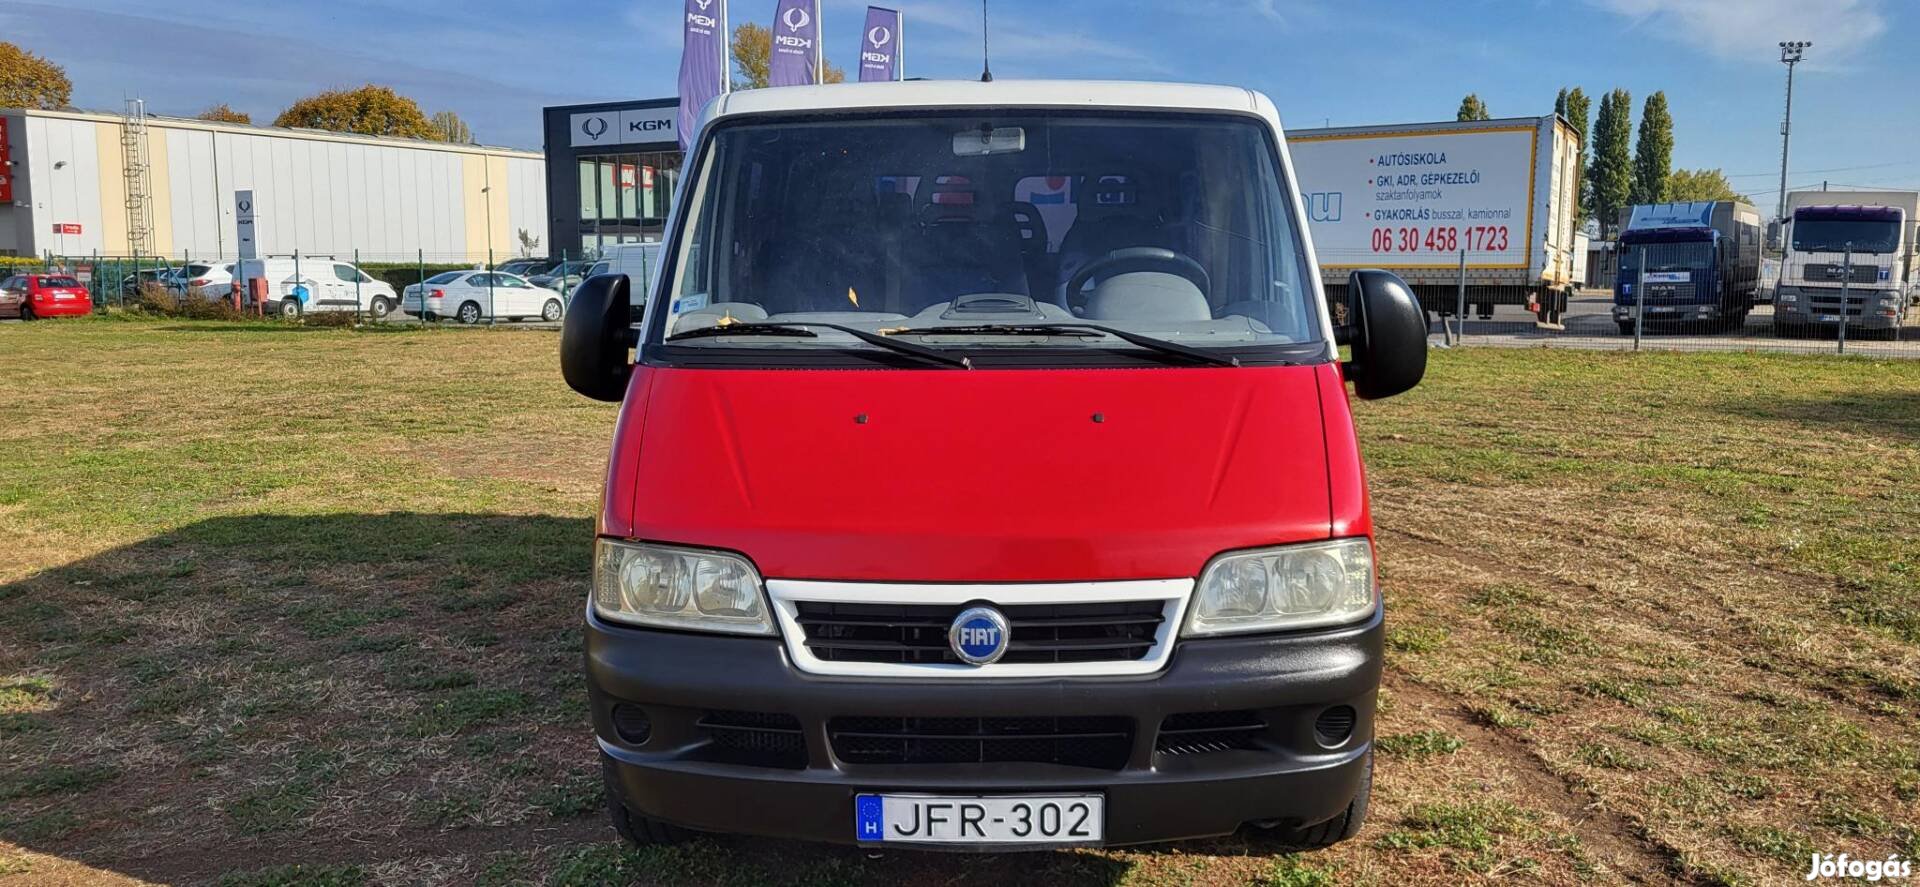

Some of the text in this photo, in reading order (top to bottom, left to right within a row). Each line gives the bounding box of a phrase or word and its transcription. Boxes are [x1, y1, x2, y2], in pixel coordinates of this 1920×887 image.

[629, 119, 671, 132] KGM
[1377, 151, 1447, 167] AUTÓSISKOLA
[1421, 169, 1480, 186] GÉPKEZELŐI
[1375, 188, 1442, 202] szaktanfolyamok
[1374, 207, 1430, 221] GYAKORLÁS
[1468, 207, 1512, 219] kamionnal
[1372, 225, 1508, 252] 06 30 458 1723
[960, 627, 998, 646] FIAT
[866, 803, 1090, 837] H JFR-302
